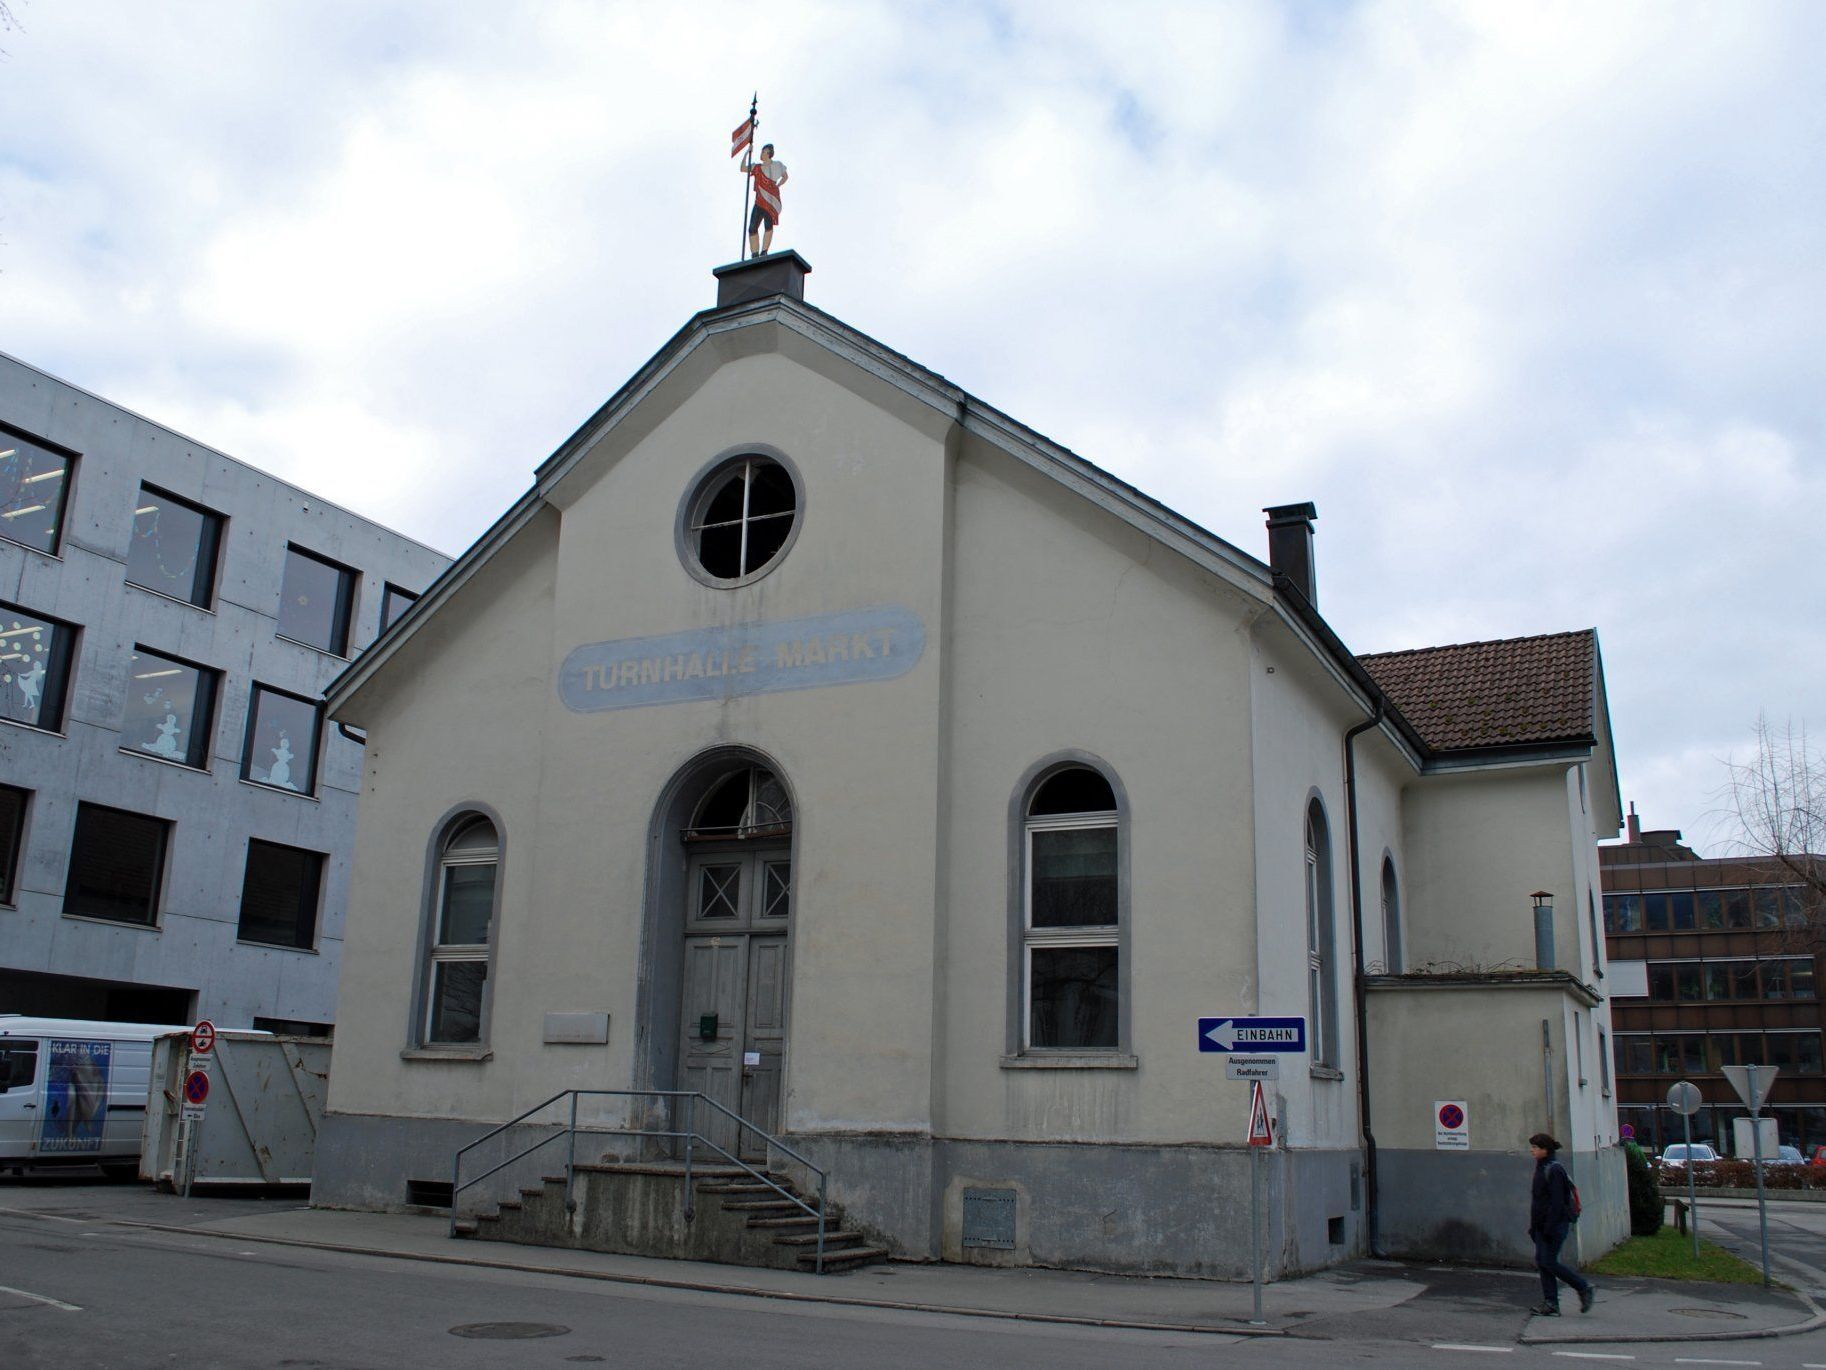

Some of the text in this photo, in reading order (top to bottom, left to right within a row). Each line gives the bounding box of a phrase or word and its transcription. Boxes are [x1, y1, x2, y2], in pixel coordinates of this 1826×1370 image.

[583, 630, 897, 691] TURNHALLE MARKT
[1237, 1029, 1293, 1041] EINBAHN
[52, 1042, 110, 1055] KLAR IN DIE
[1229, 1057, 1276, 1066] Ausgenommen
[1236, 1068, 1269, 1076] Radfahrer
[42, 1137, 101, 1151] ZUKUNFT
